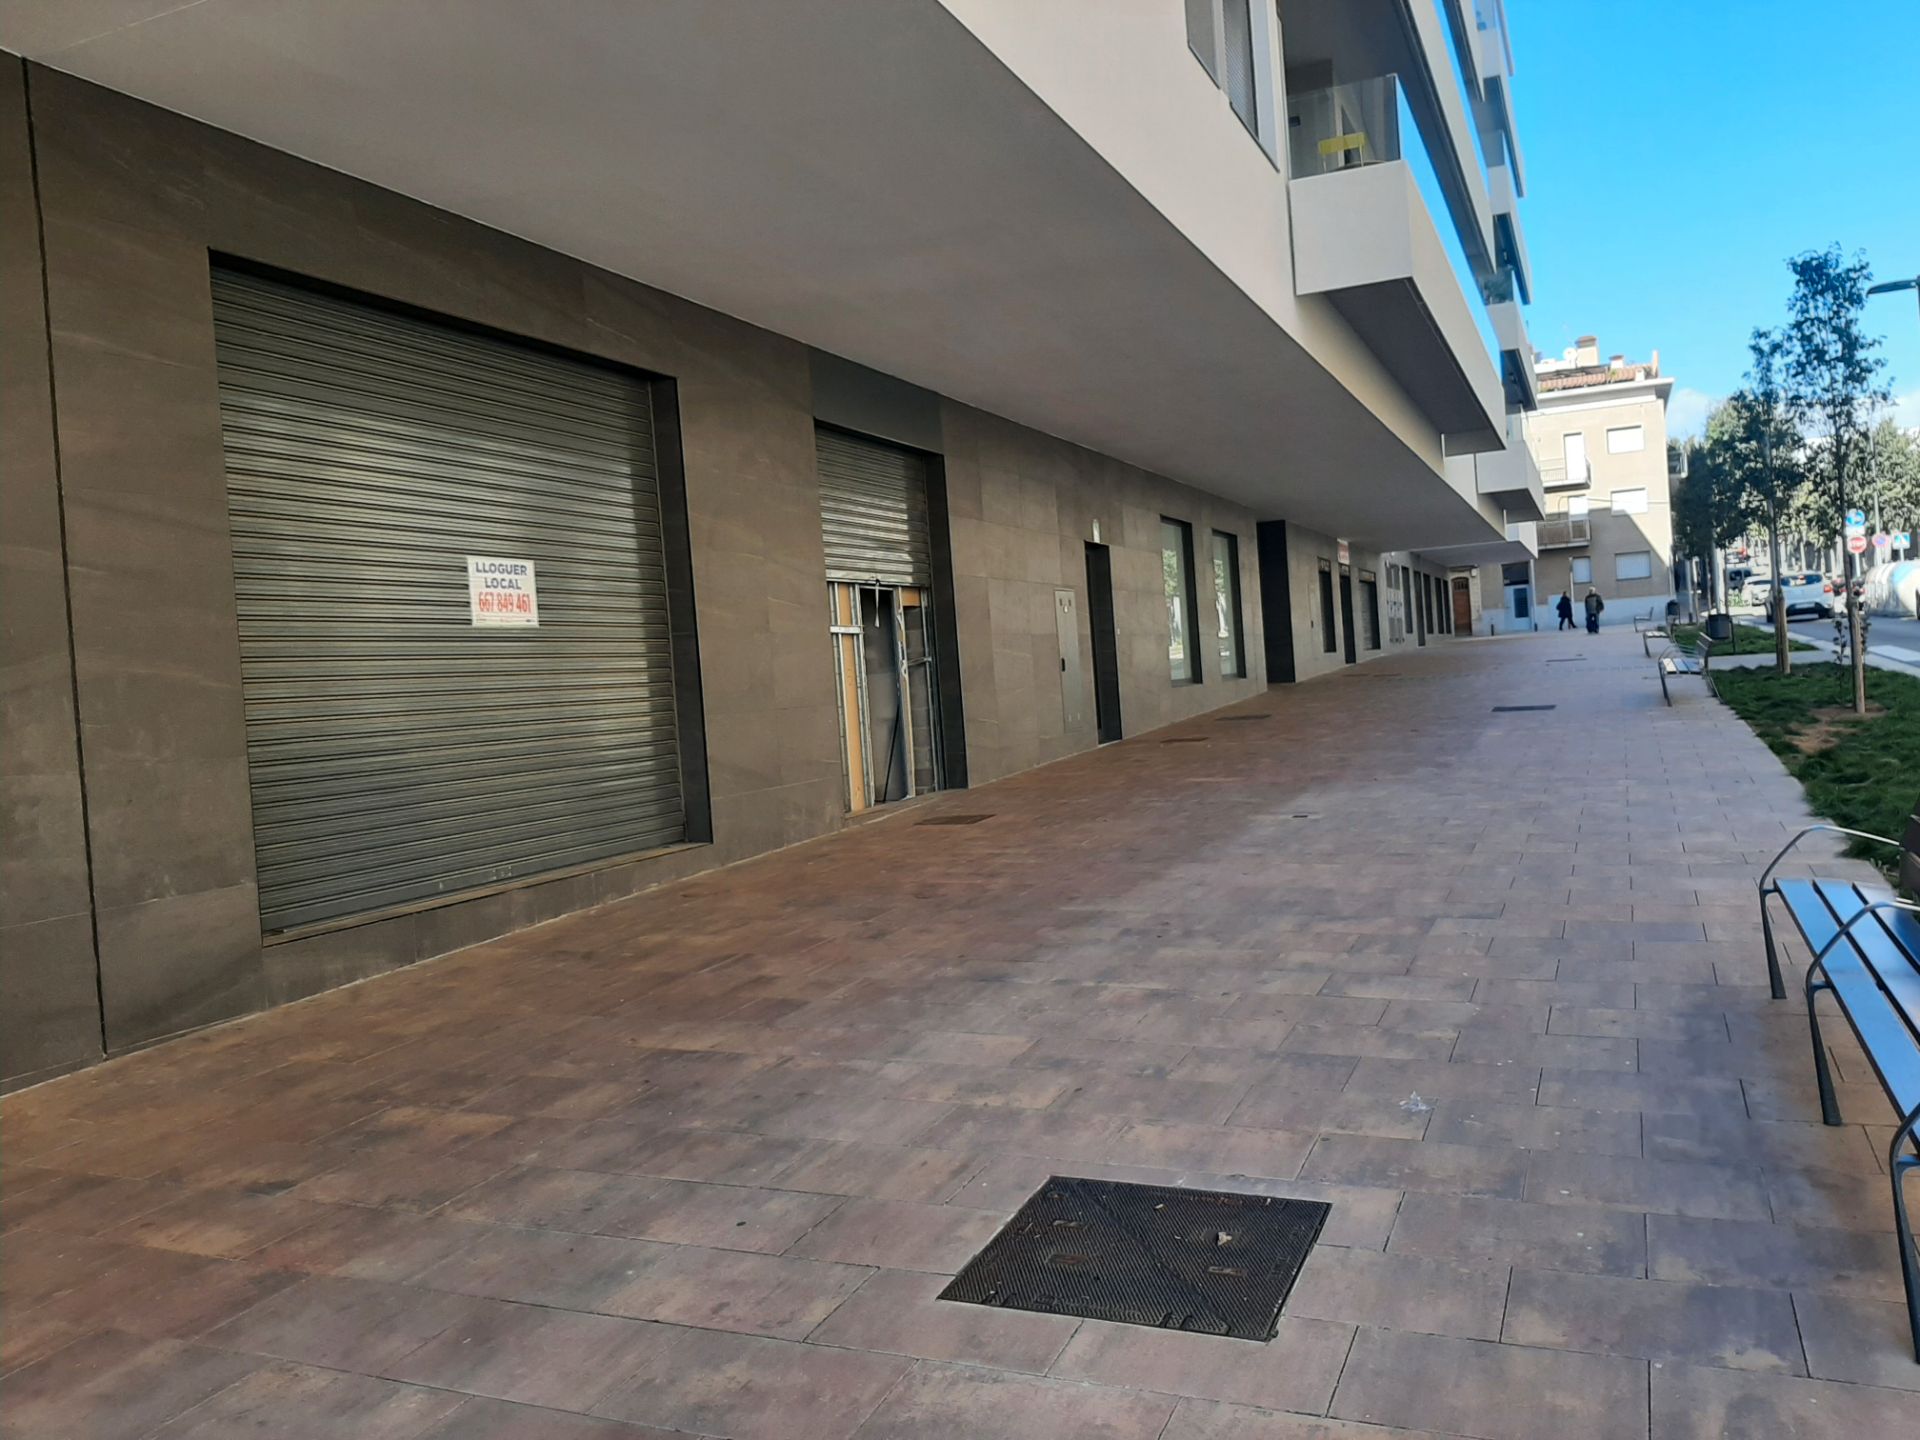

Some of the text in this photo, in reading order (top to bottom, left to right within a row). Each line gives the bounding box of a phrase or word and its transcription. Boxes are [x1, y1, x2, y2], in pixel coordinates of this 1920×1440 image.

[475, 561, 527, 576] LLOGUER
[485, 577, 522, 590] LOCAL
[496, 591, 514, 613] 849
